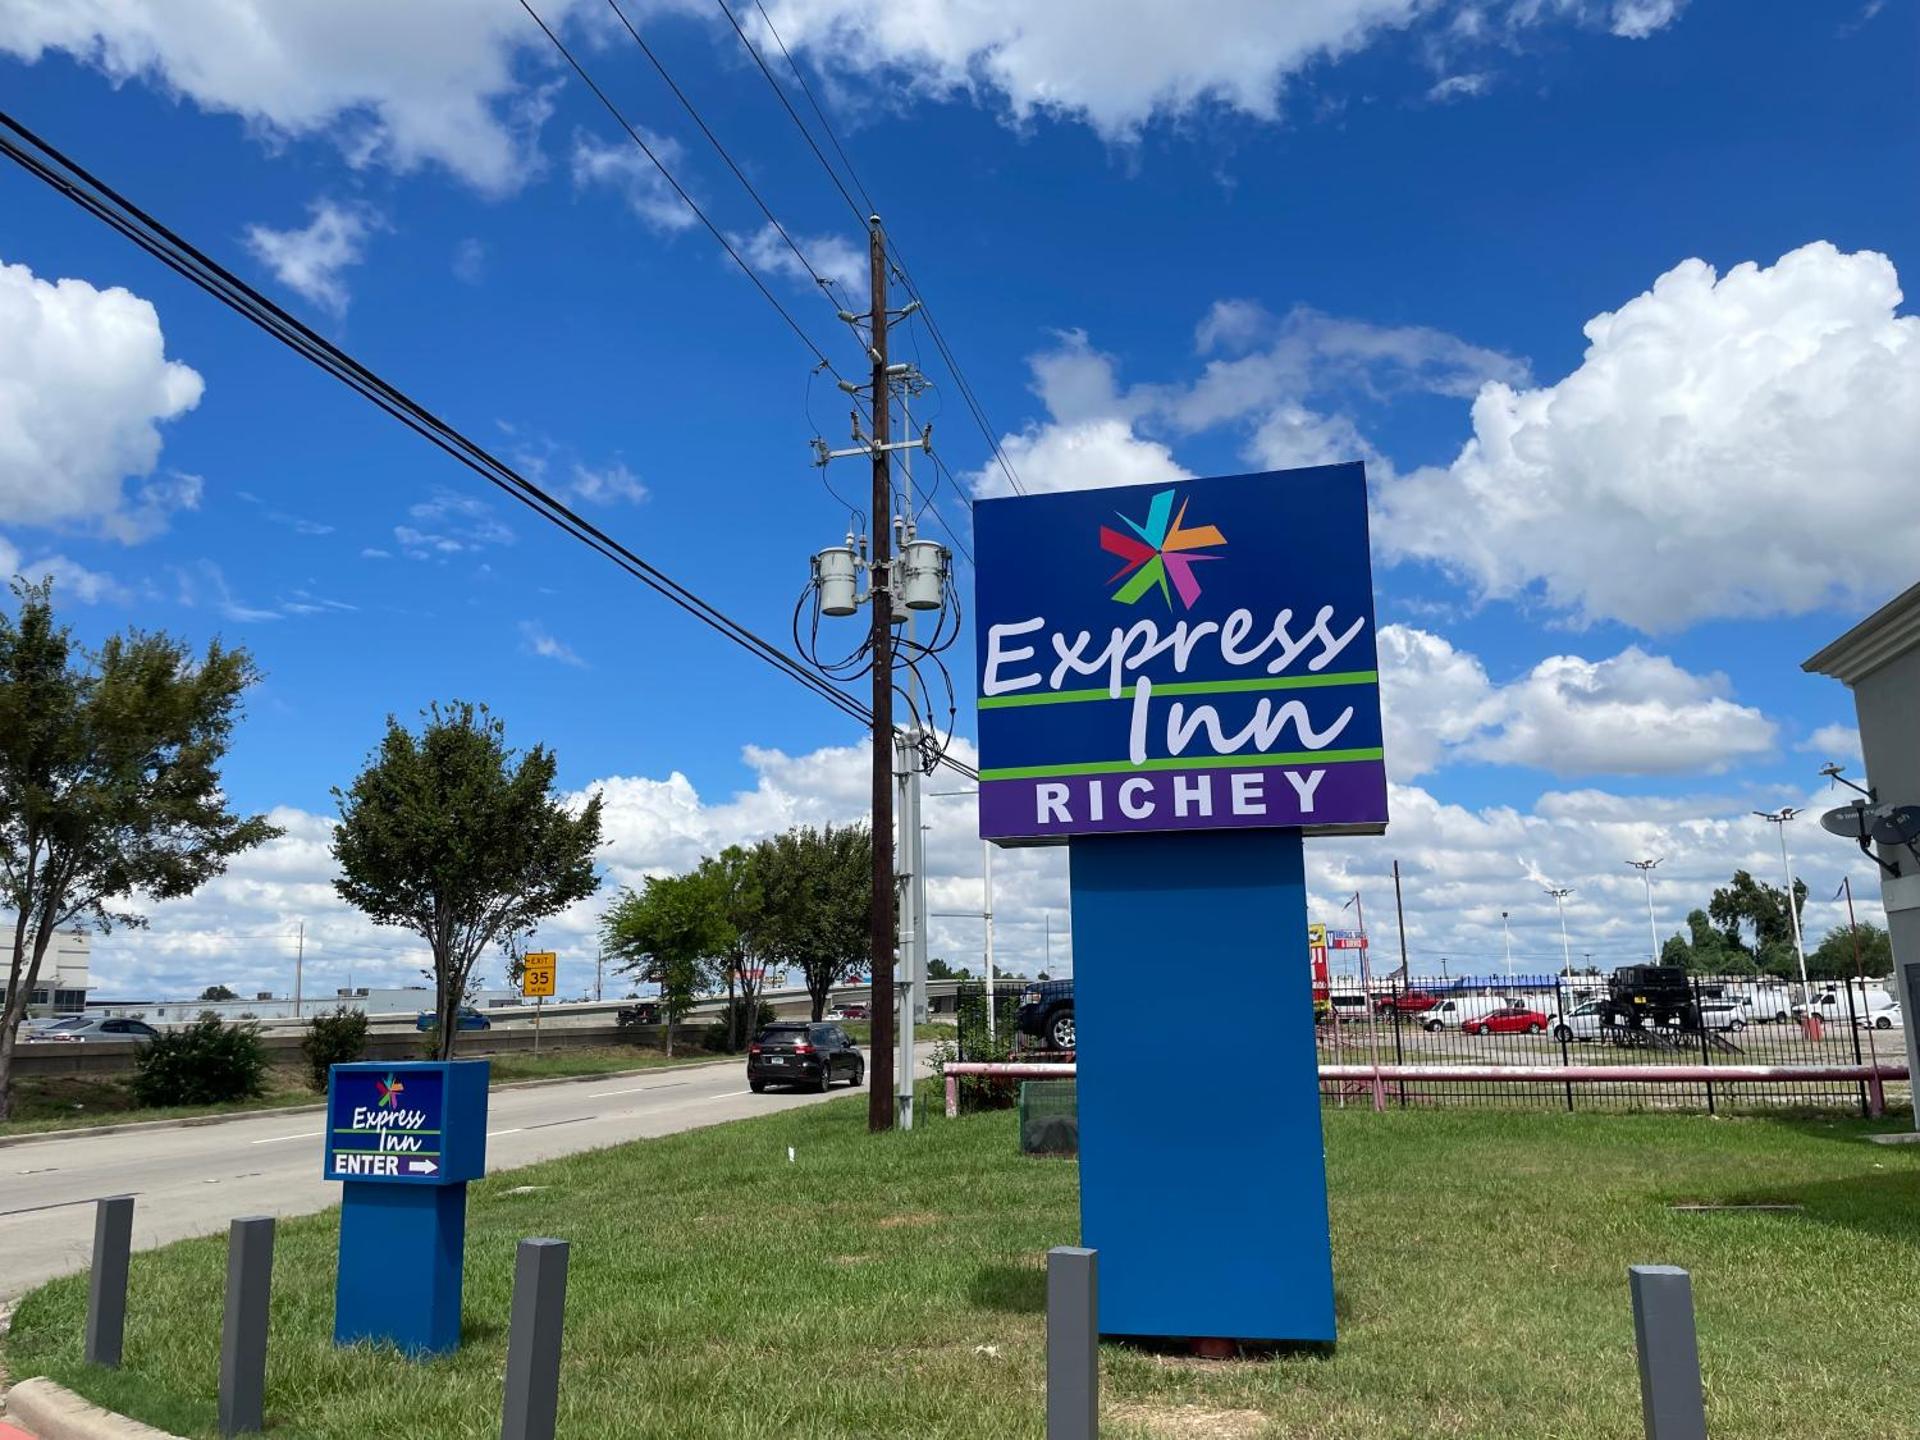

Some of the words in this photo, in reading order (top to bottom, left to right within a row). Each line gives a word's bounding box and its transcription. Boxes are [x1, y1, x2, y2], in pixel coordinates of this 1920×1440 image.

[983, 605, 1365, 699] Express
[1130, 676, 1354, 765] Inn
[1036, 769, 1326, 824] RICHEY
[530, 957, 548, 965] EXIT
[530, 972, 549, 984] 35
[352, 1106, 426, 1133] Express
[379, 1127, 422, 1152] Inn
[335, 1154, 399, 1175] ENTER
